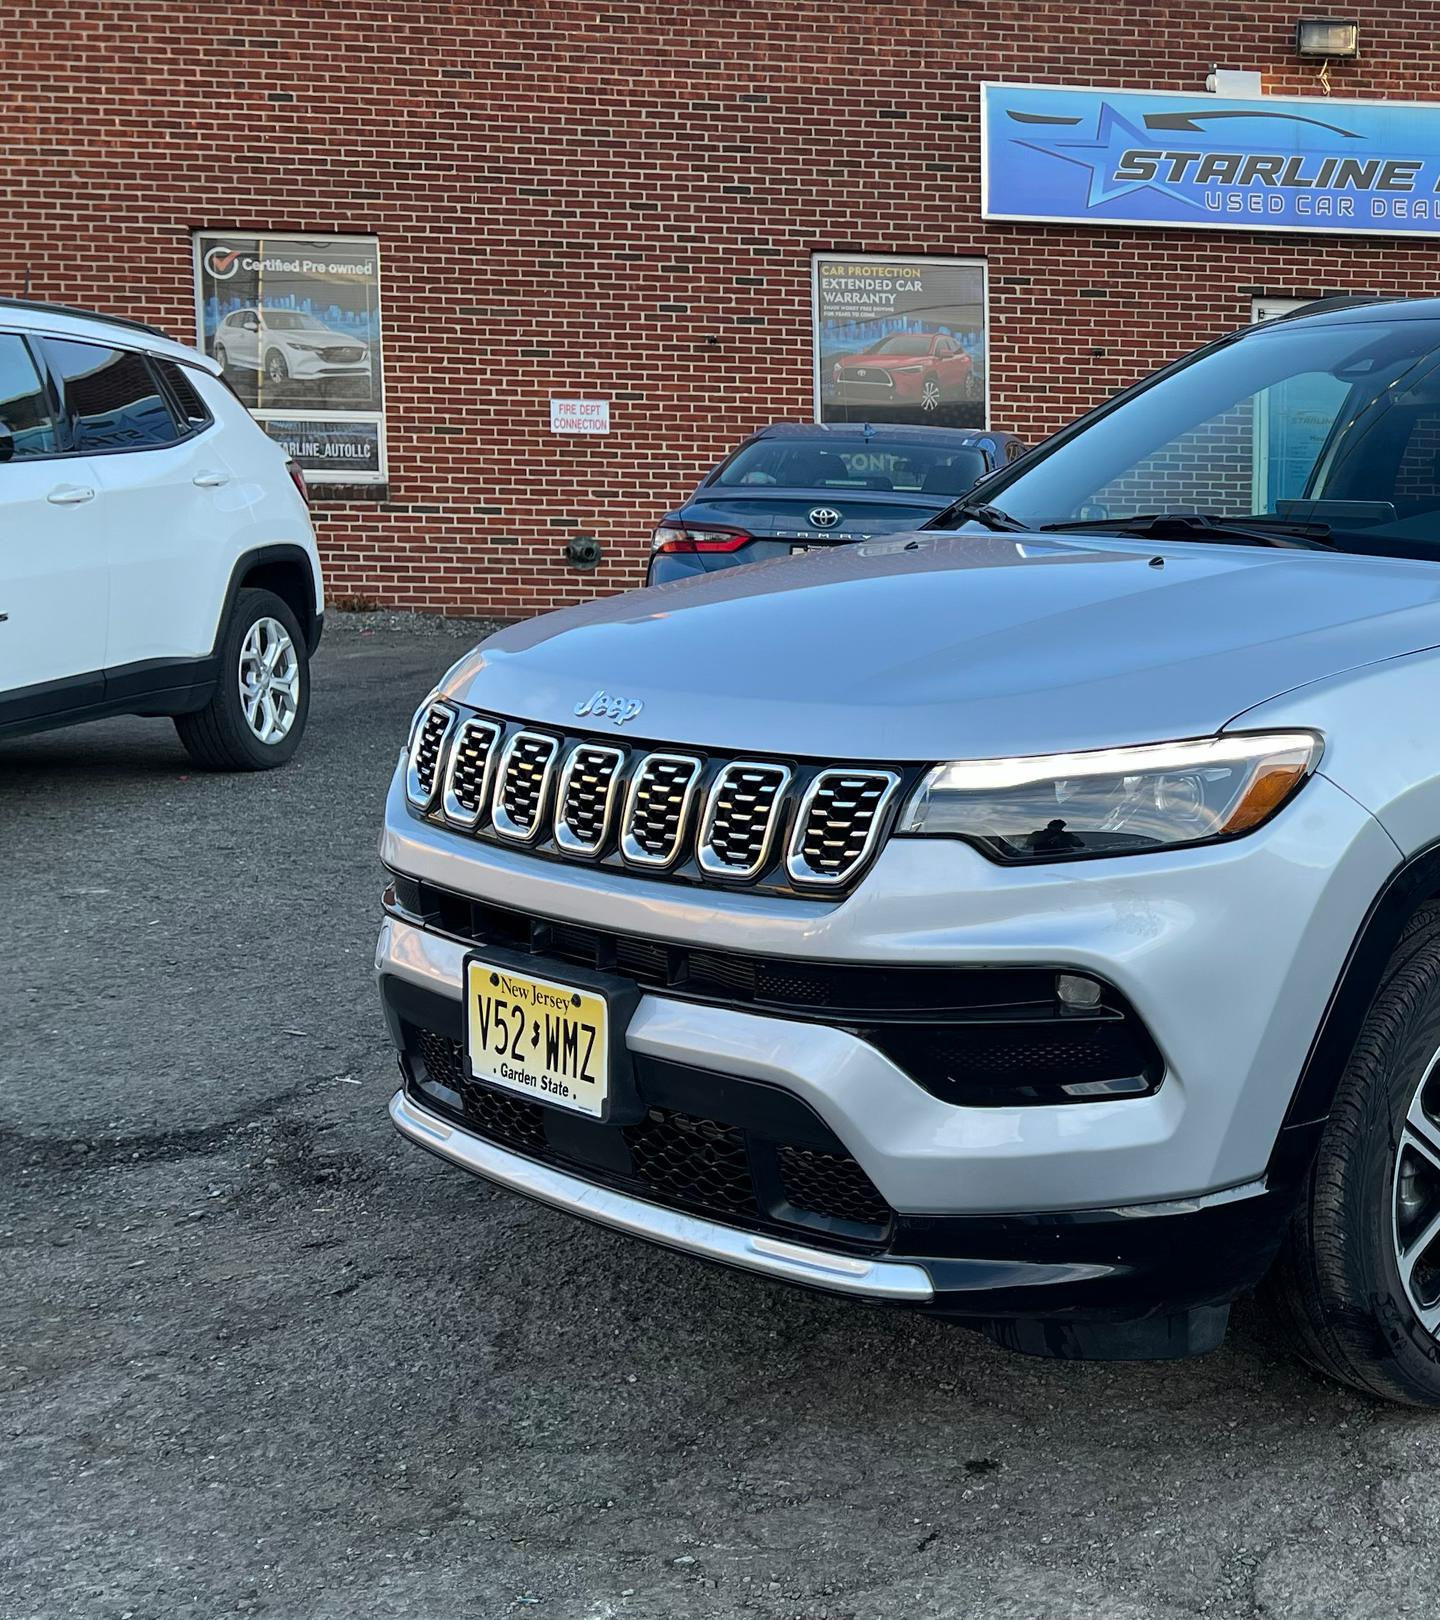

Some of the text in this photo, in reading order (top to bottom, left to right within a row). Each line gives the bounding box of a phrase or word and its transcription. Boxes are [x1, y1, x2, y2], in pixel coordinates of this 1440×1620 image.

[1113, 148, 1422, 194] STARLINE
[1205, 191, 1284, 215] USED
[1296, 195, 1355, 218] CAR
[242, 257, 300, 272] Certified
[821, 266, 921, 278] CAR PROTECTION
[822, 278, 922, 291] EXTENDED CAR
[823, 292, 896, 304] WARRANTY
[559, 404, 601, 416] FIRE DEPT
[553, 417, 607, 430] CONNECTION
[574, 690, 644, 726] Jeep
[501, 976, 571, 1015] New Jersey
[478, 995, 596, 1084] V52 WMZ
[500, 1063, 569, 1097] Garden State
